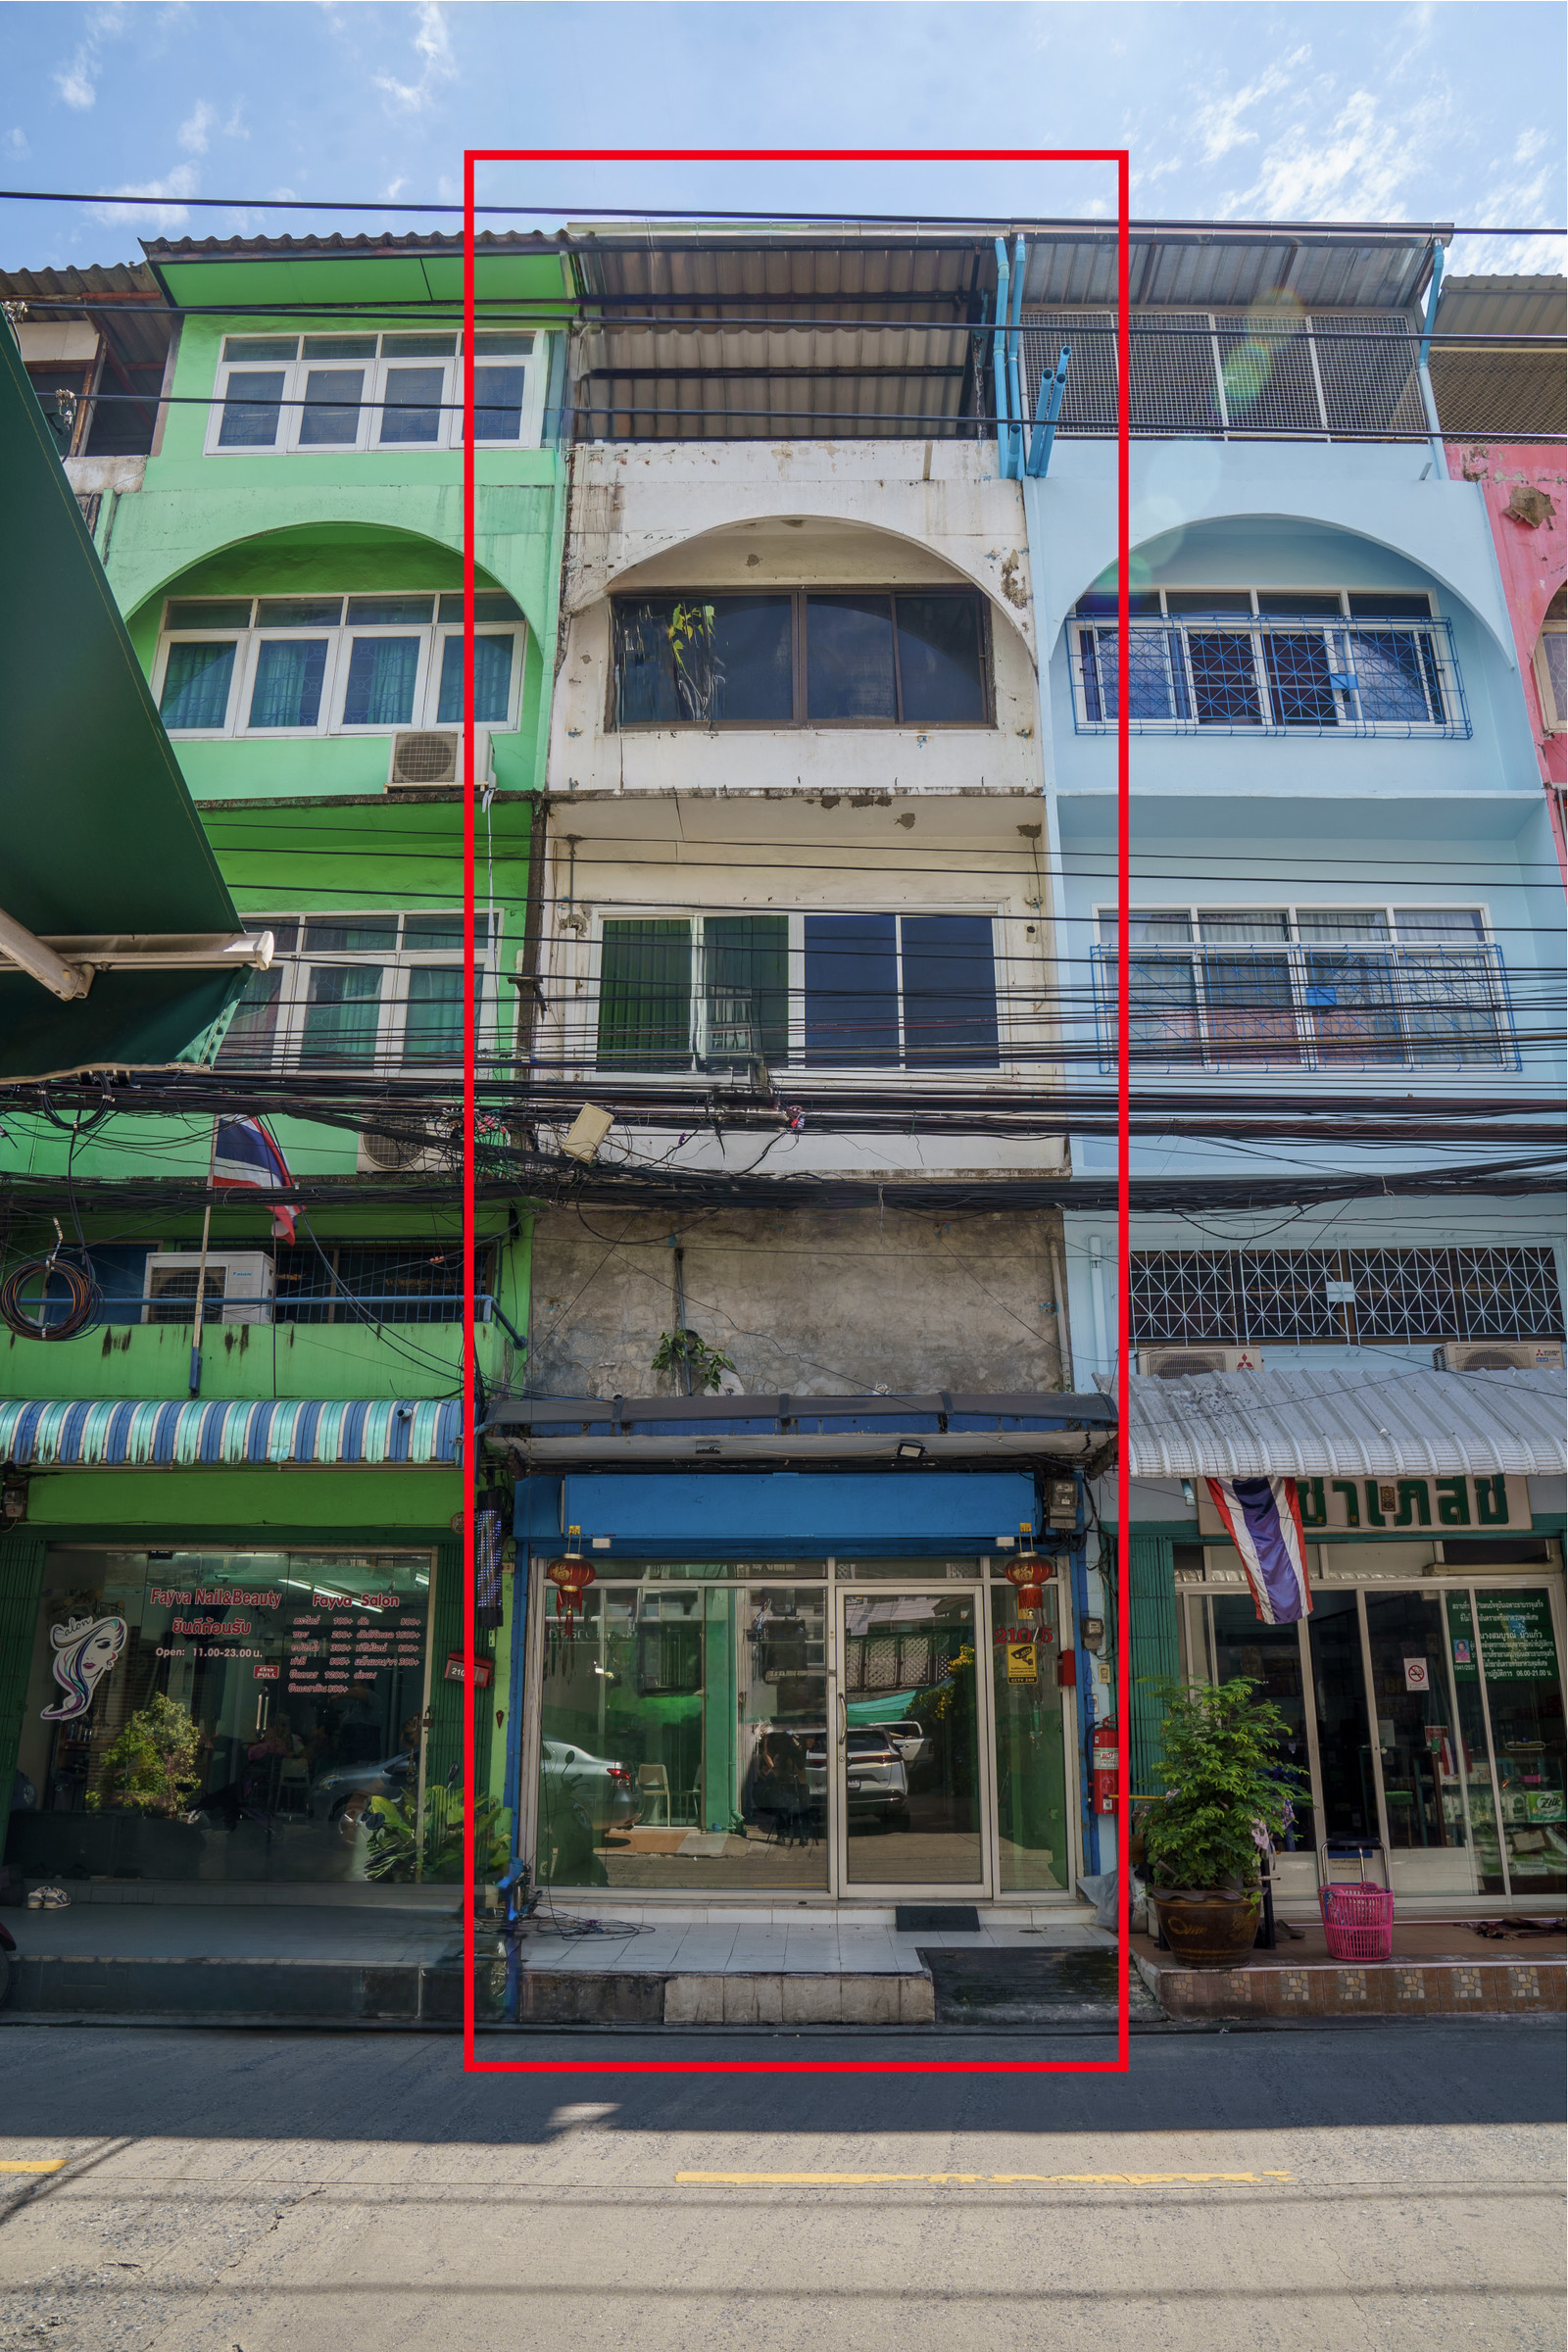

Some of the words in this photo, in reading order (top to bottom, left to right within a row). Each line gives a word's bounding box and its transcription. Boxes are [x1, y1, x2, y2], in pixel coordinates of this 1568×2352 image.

[151, 1588, 192, 1607] Fayva
[194, 1588, 282, 1609] Nail&Beauty
[313, 1593, 353, 1610] Fayva
[361, 1592, 400, 1607] Salon
[54, 1617, 92, 1639] Salon
[172, 1616, 252, 1635] ยินดีต้อนรับ
[995, 1627, 1054, 1643] 210/5
[155, 1646, 185, 1659] Open:
[192, 1647, 252, 1658] 11.00-23.00
[323, 1671, 351, 1680] 1200+
[1541, 1797, 1561, 1809] Zilk
